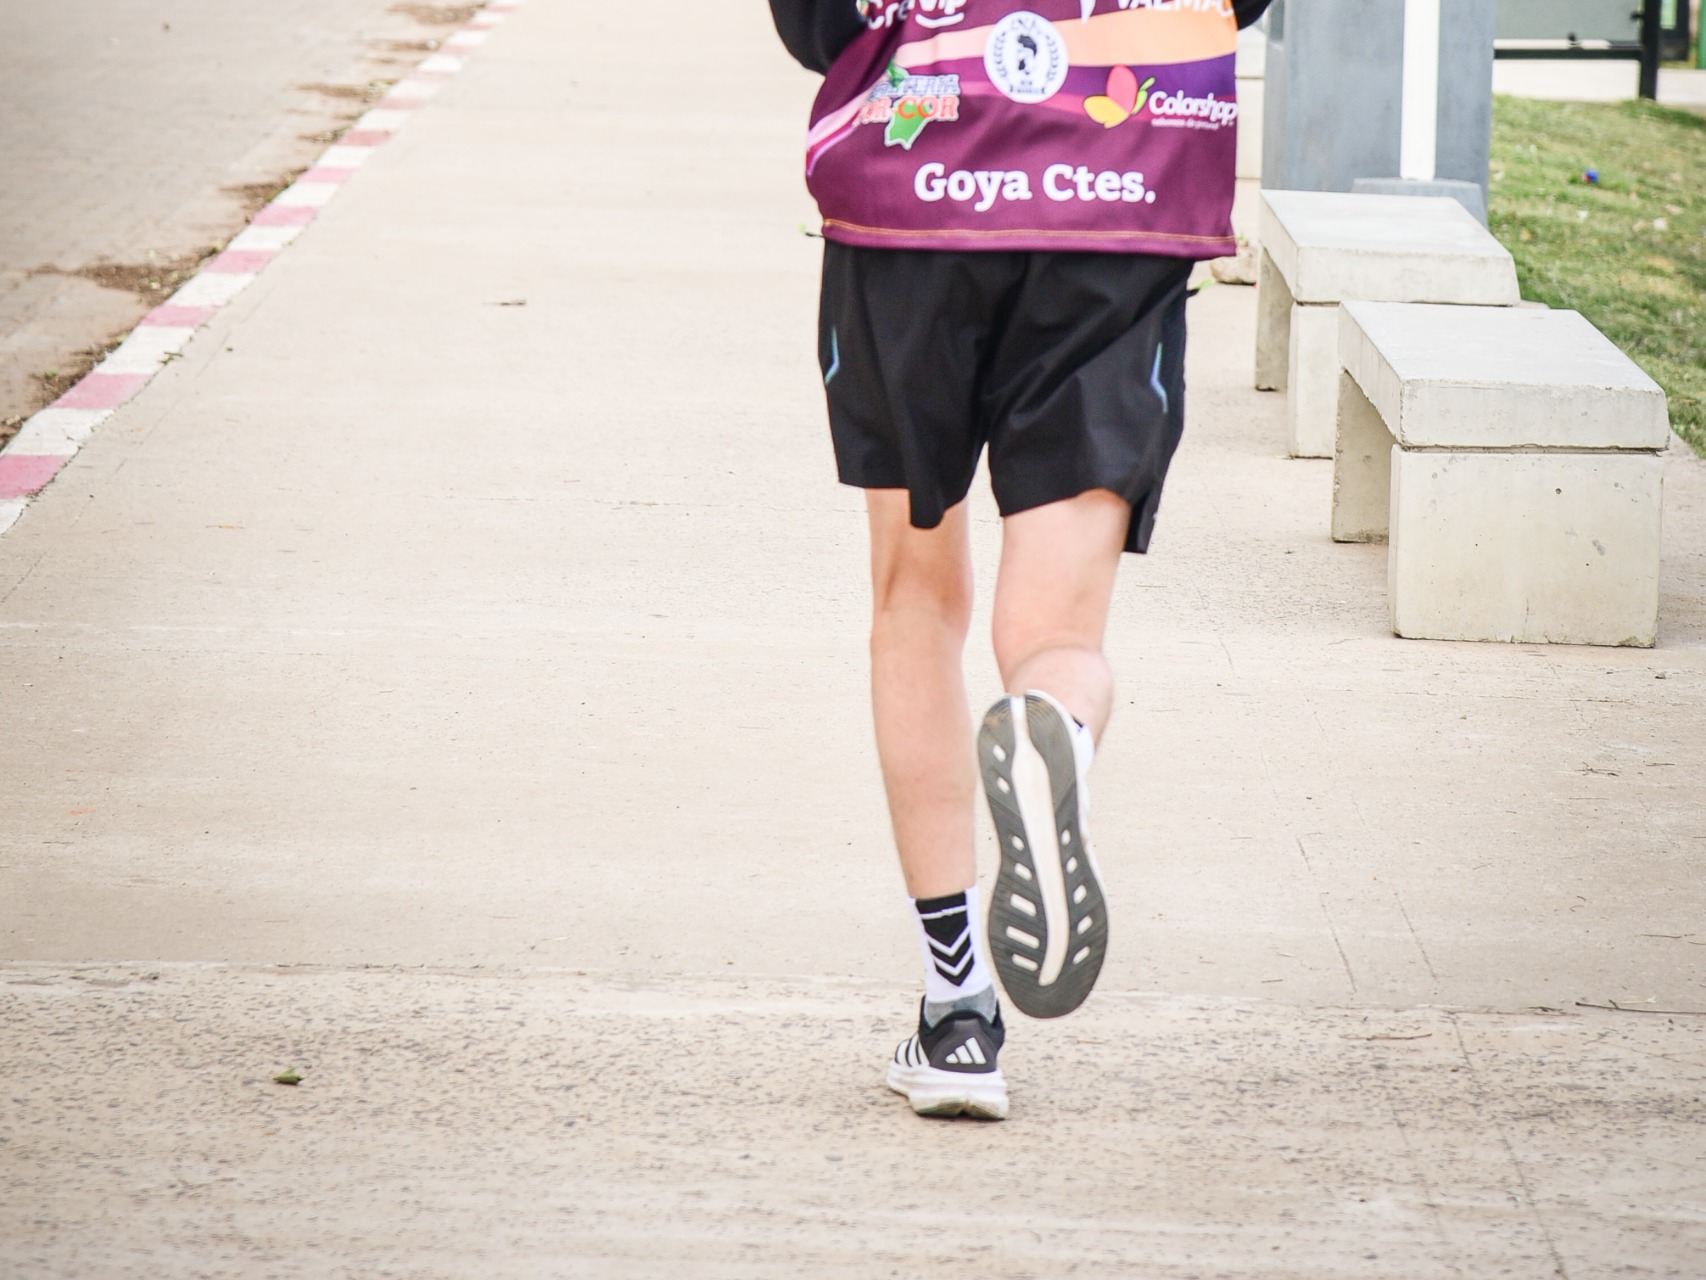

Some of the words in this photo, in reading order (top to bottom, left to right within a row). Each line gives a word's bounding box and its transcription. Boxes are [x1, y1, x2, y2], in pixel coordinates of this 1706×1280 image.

[1148, 89, 1238, 127] Colorshop
[913, 161, 1034, 213] Goya
[1042, 162, 1157, 205] Ctes.
